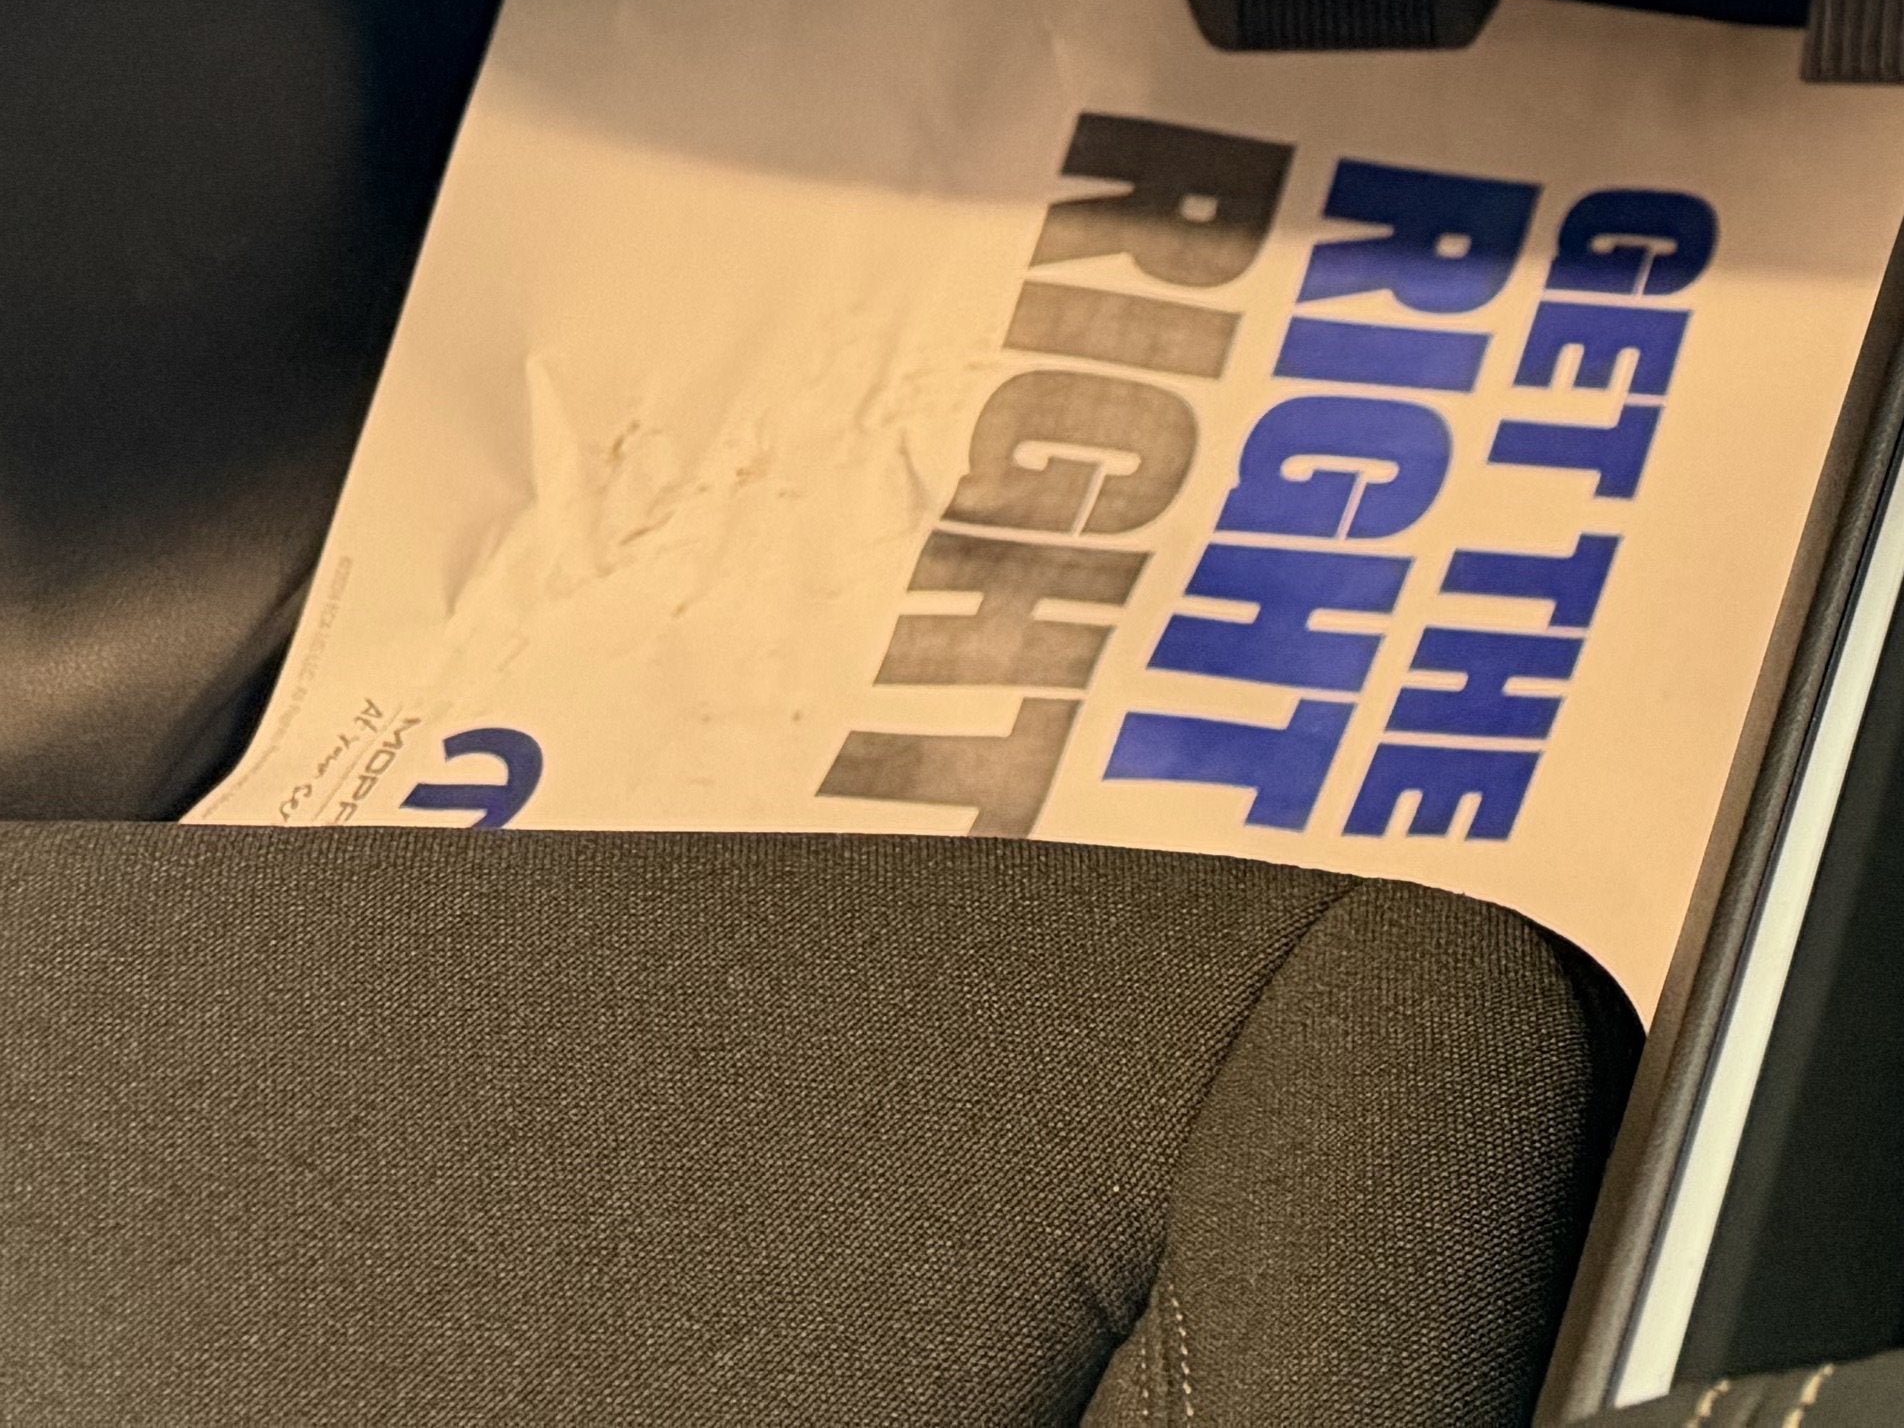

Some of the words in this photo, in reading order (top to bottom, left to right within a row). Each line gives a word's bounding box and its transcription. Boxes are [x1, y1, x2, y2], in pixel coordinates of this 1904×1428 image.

[815, 110, 1296, 840] RIGHT
[1101, 159, 1544, 833] RIGHT
[1487, 189, 1718, 500] GET
[1341, 532, 1622, 842] THE
